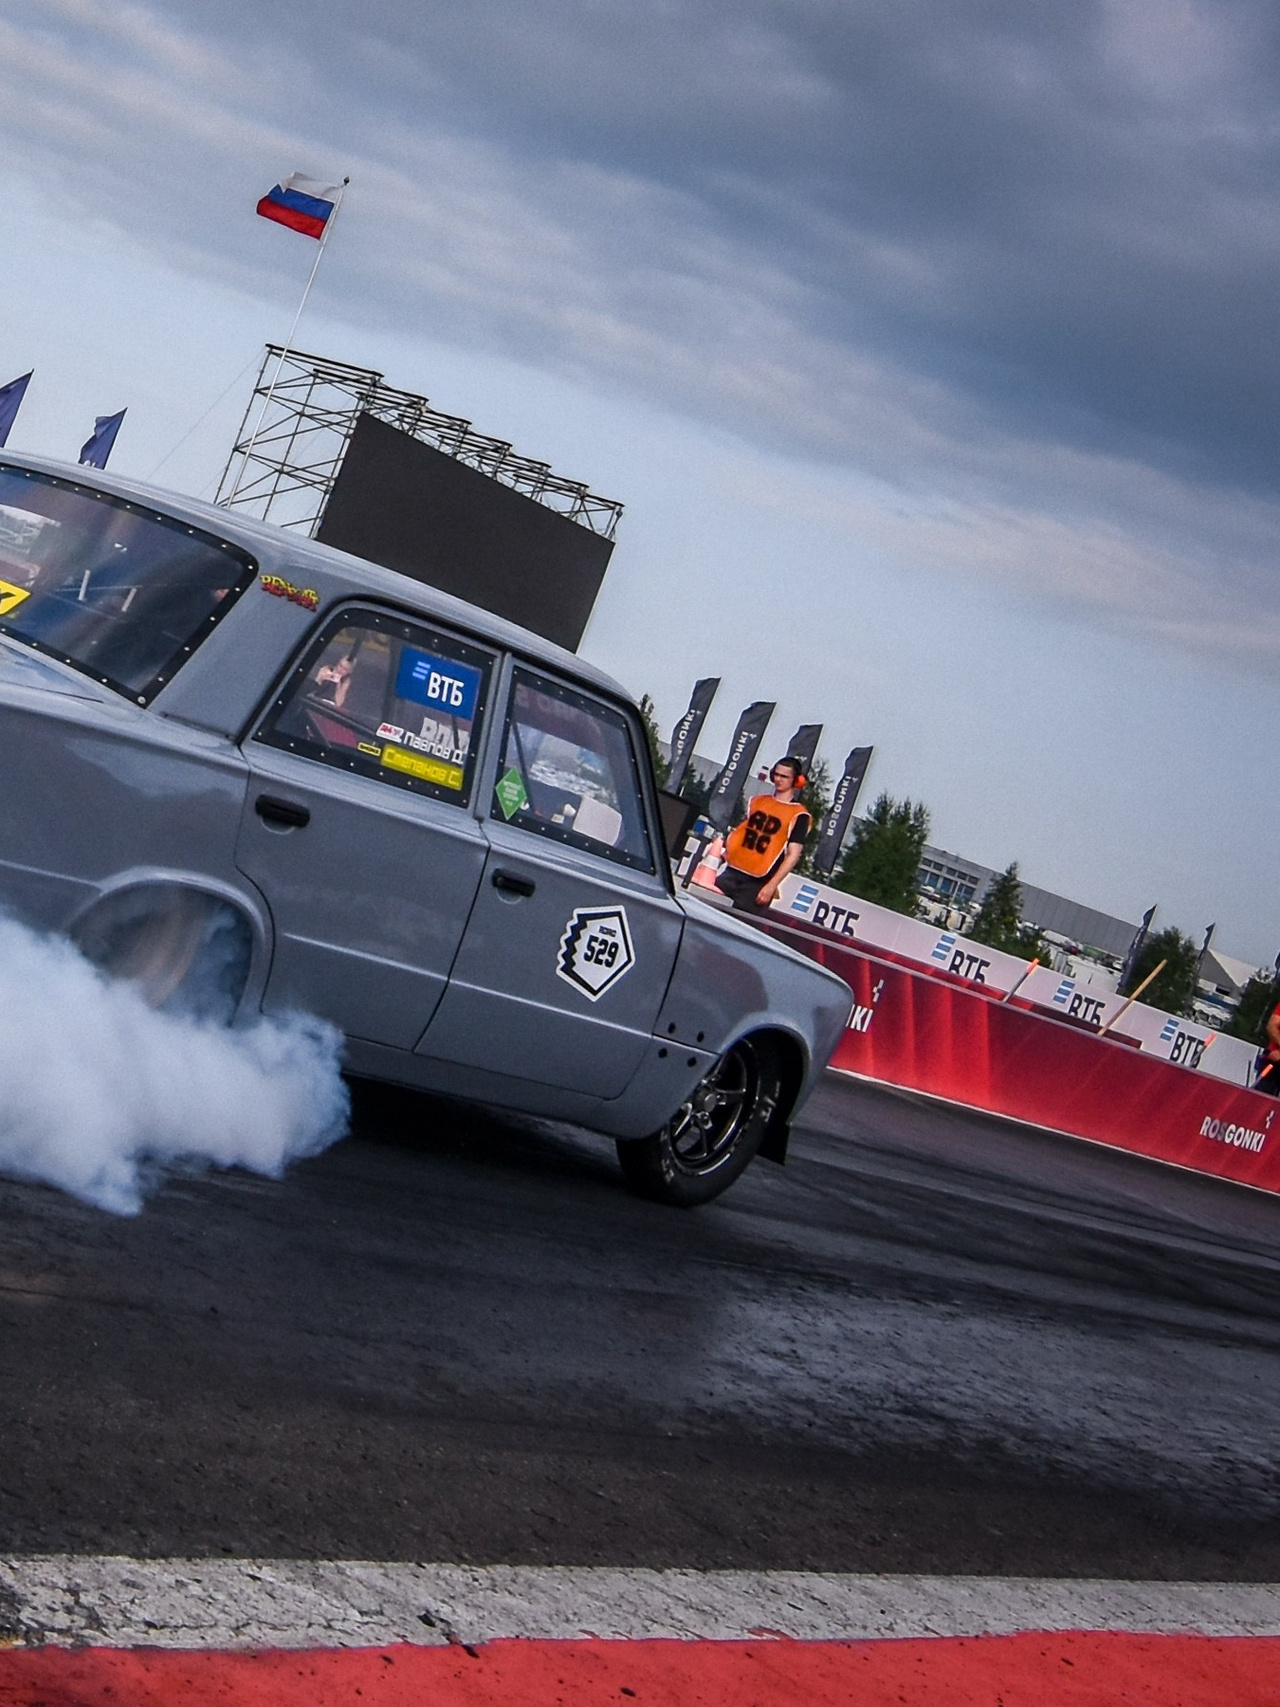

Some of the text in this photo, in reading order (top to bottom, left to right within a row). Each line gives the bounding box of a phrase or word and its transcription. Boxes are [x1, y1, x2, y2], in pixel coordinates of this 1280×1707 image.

[427, 671, 465, 706] ВТБ
[404, 731, 450, 760] Павлов
[584, 934, 619, 969] 529
[1199, 1115, 1266, 1153] ROSGONKI
